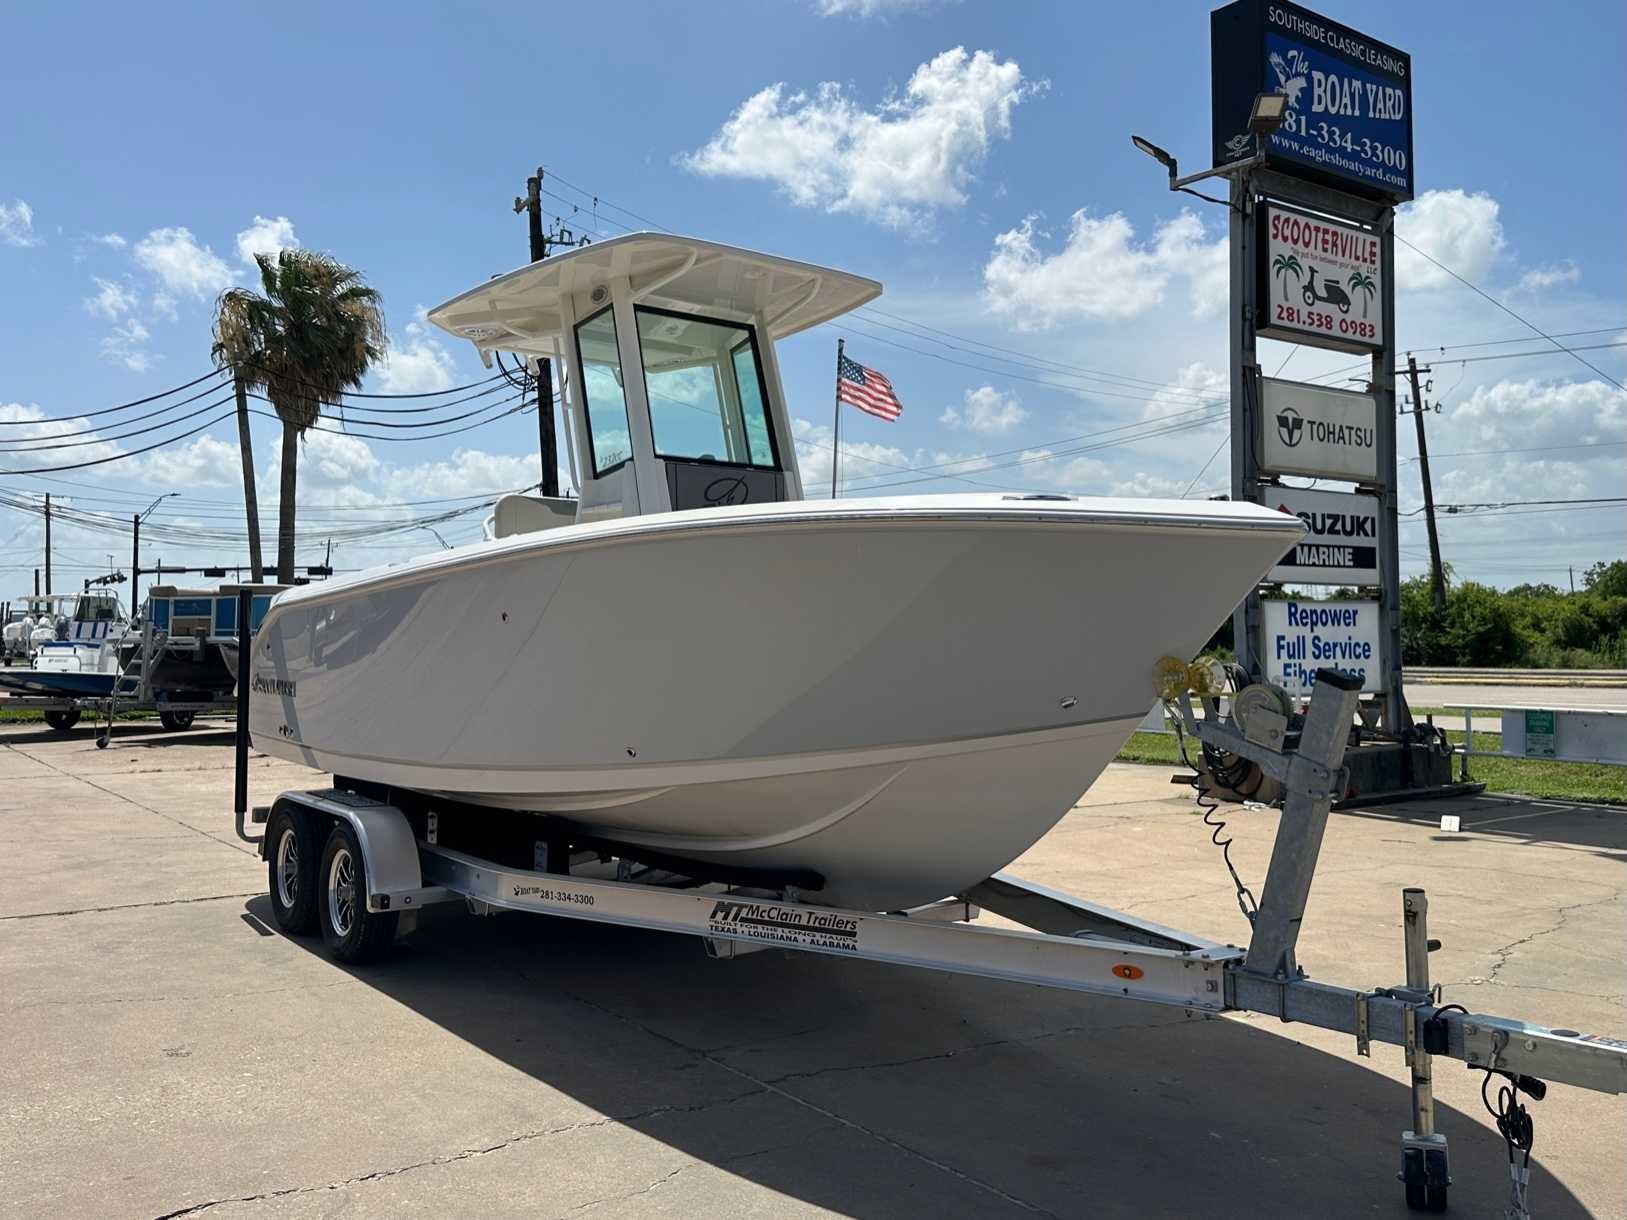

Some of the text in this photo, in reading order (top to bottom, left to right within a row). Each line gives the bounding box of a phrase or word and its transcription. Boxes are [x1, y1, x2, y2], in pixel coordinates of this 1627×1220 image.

[1268, 6, 1406, 76] SOUTHSIDE CLASSIC LEASING
[1287, 49, 1310, 75] The
[1311, 70, 1405, 121] BOAT YARD
[1280, 109, 1407, 171] 81-334-3300
[1270, 133, 1407, 188] www.eaglesboatyard.com
[1271, 214, 1377, 265] SCOOTERVILLE
[1276, 304, 1376, 339] 281.538 0983
[1307, 420, 1373, 448] TOHATSU
[1296, 511, 1376, 538] SUZUKI
[1296, 545, 1354, 567] MARINE
[1287, 602, 1359, 633] Repower
[1276, 634, 1372, 661] Full Service
[540, 889, 595, 905] 281-334-3300
[745, 904, 801, 923] McClain
[802, 911, 858, 930] Trailers
[710, 925, 858, 951] TEXAS LOUISIANA ALABAMA
[782, 929, 817, 938] LONG
